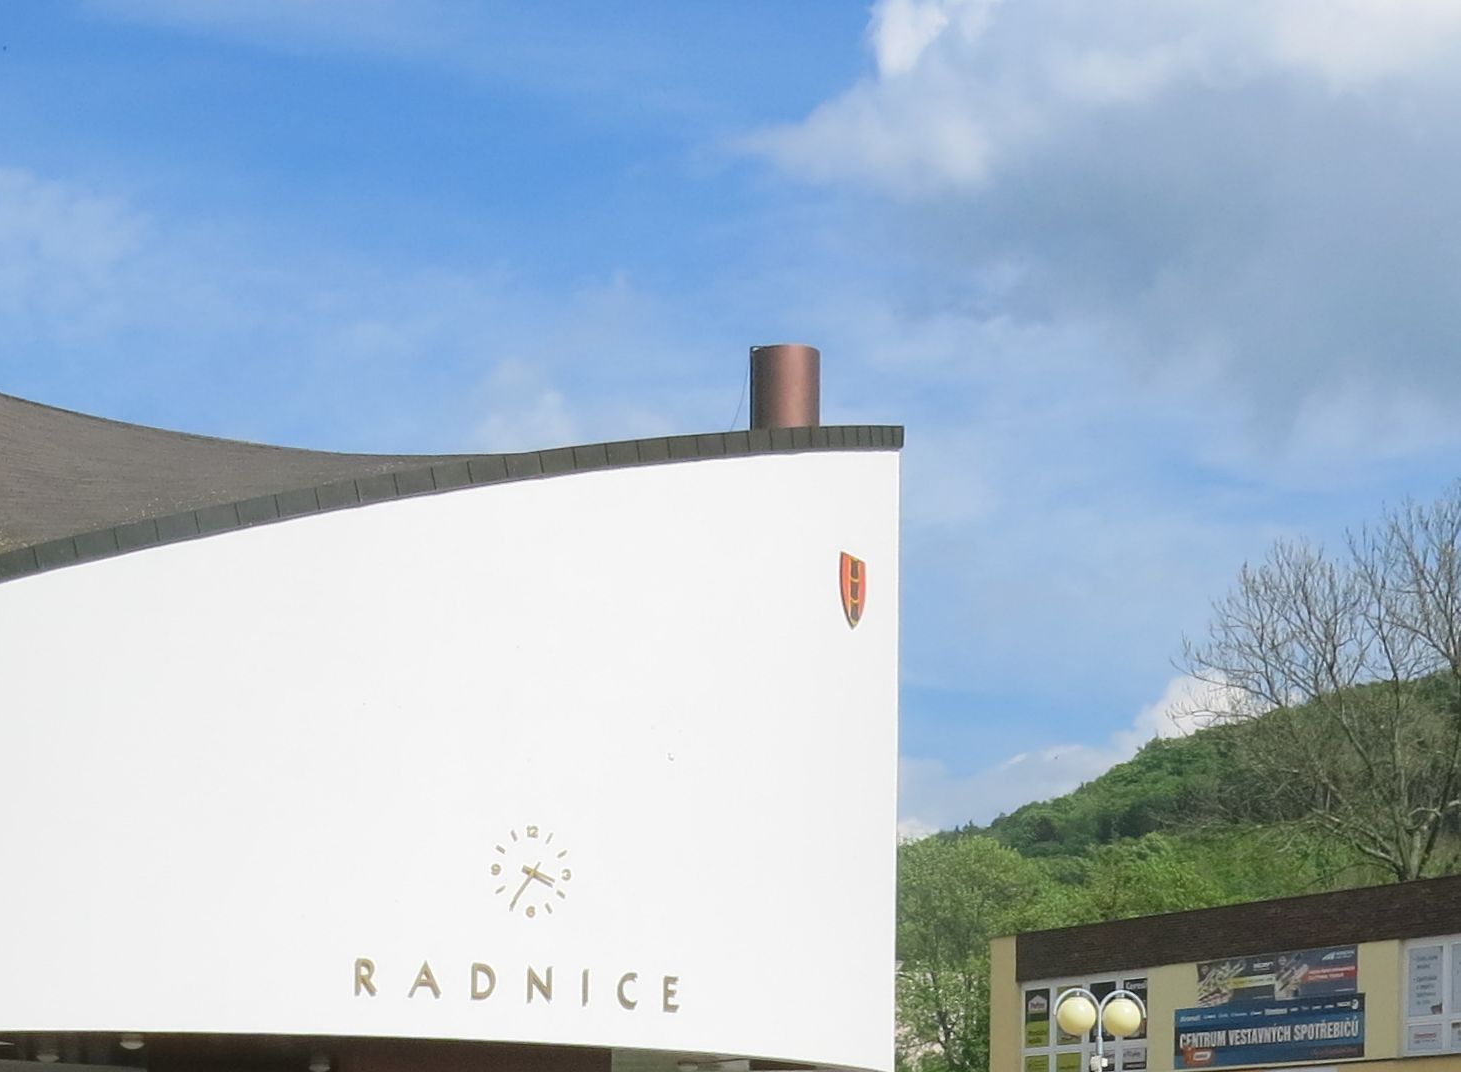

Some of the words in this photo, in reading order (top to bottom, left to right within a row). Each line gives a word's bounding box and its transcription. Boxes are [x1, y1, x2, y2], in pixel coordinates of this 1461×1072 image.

[525, 825, 539, 839] 12
[490, 863, 502, 876] 9
[560, 868, 572, 881] 3
[525, 905, 536, 918] 6
[354, 957, 680, 1013] RADNICE
[1179, 1029, 1226, 1049] CENTRUM
[1228, 1023, 1291, 1046] VESTAVNÝCH
